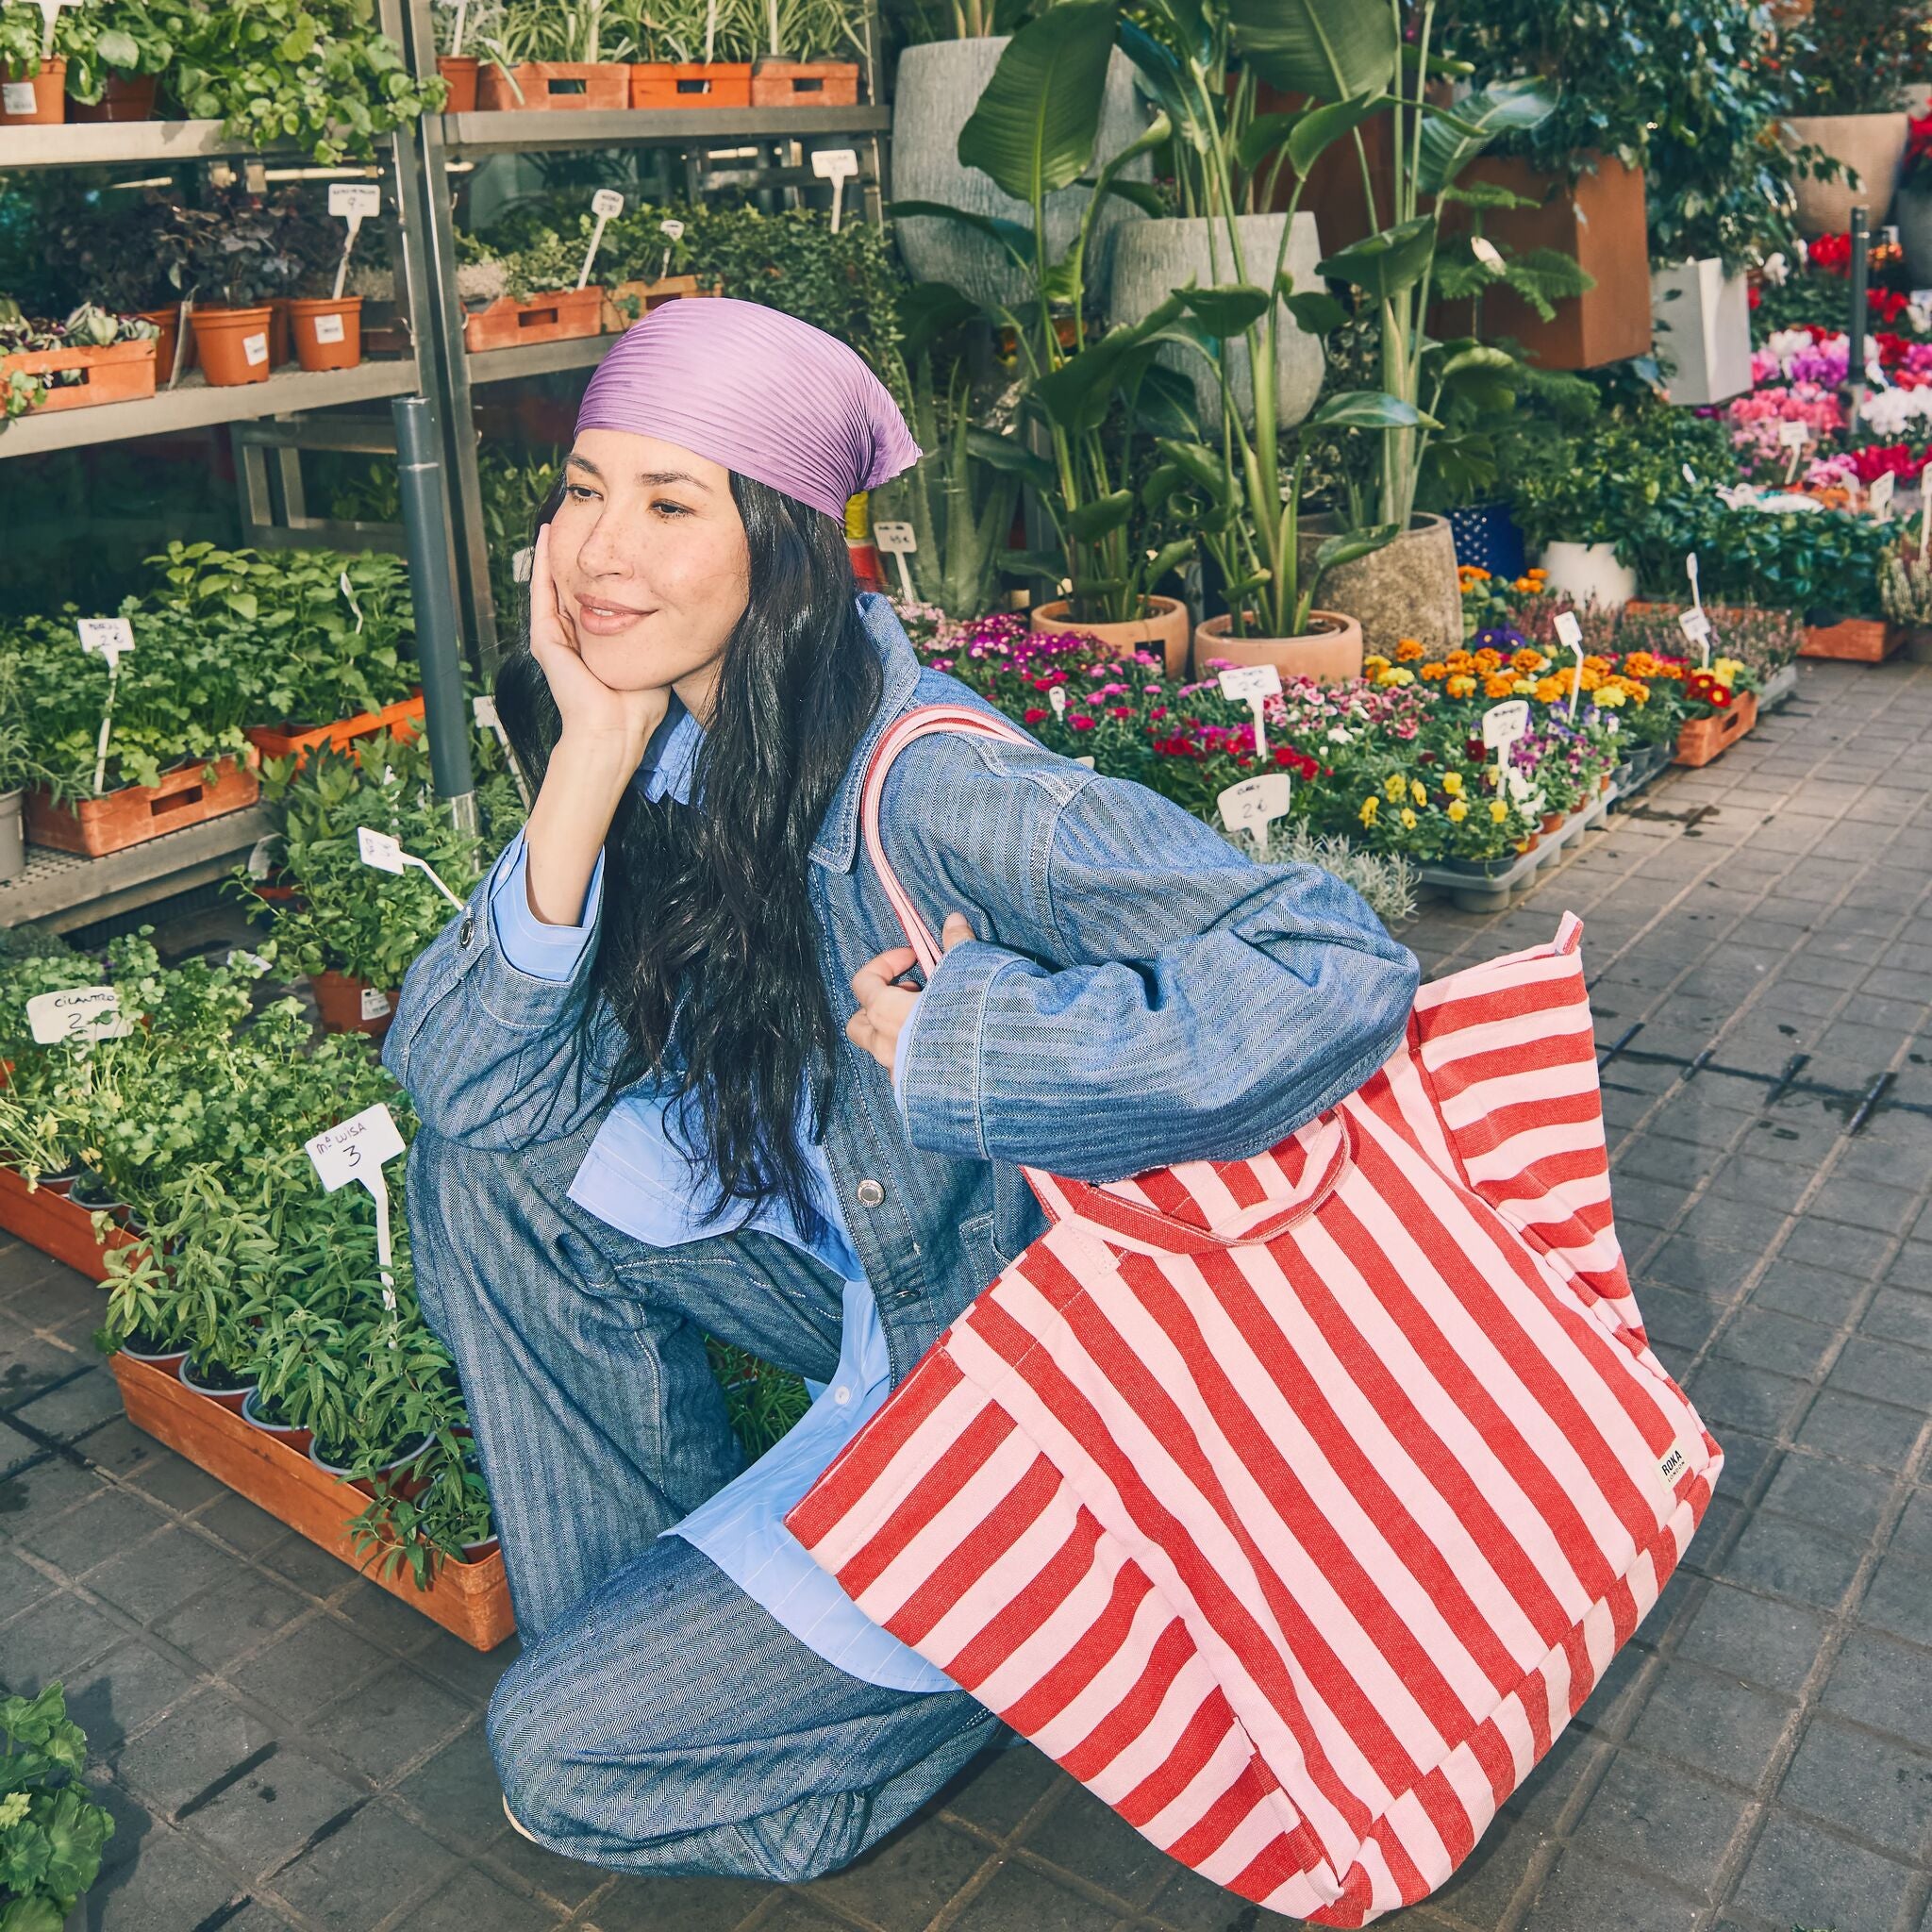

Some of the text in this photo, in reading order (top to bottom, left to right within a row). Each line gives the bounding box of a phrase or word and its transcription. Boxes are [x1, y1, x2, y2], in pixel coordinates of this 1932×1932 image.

[67, 1012, 86, 1029] 2
[342, 1144, 361, 1167] 3
[1661, 1450, 1682, 1476] ROKA
[1667, 1461, 1685, 1483] LONDON
